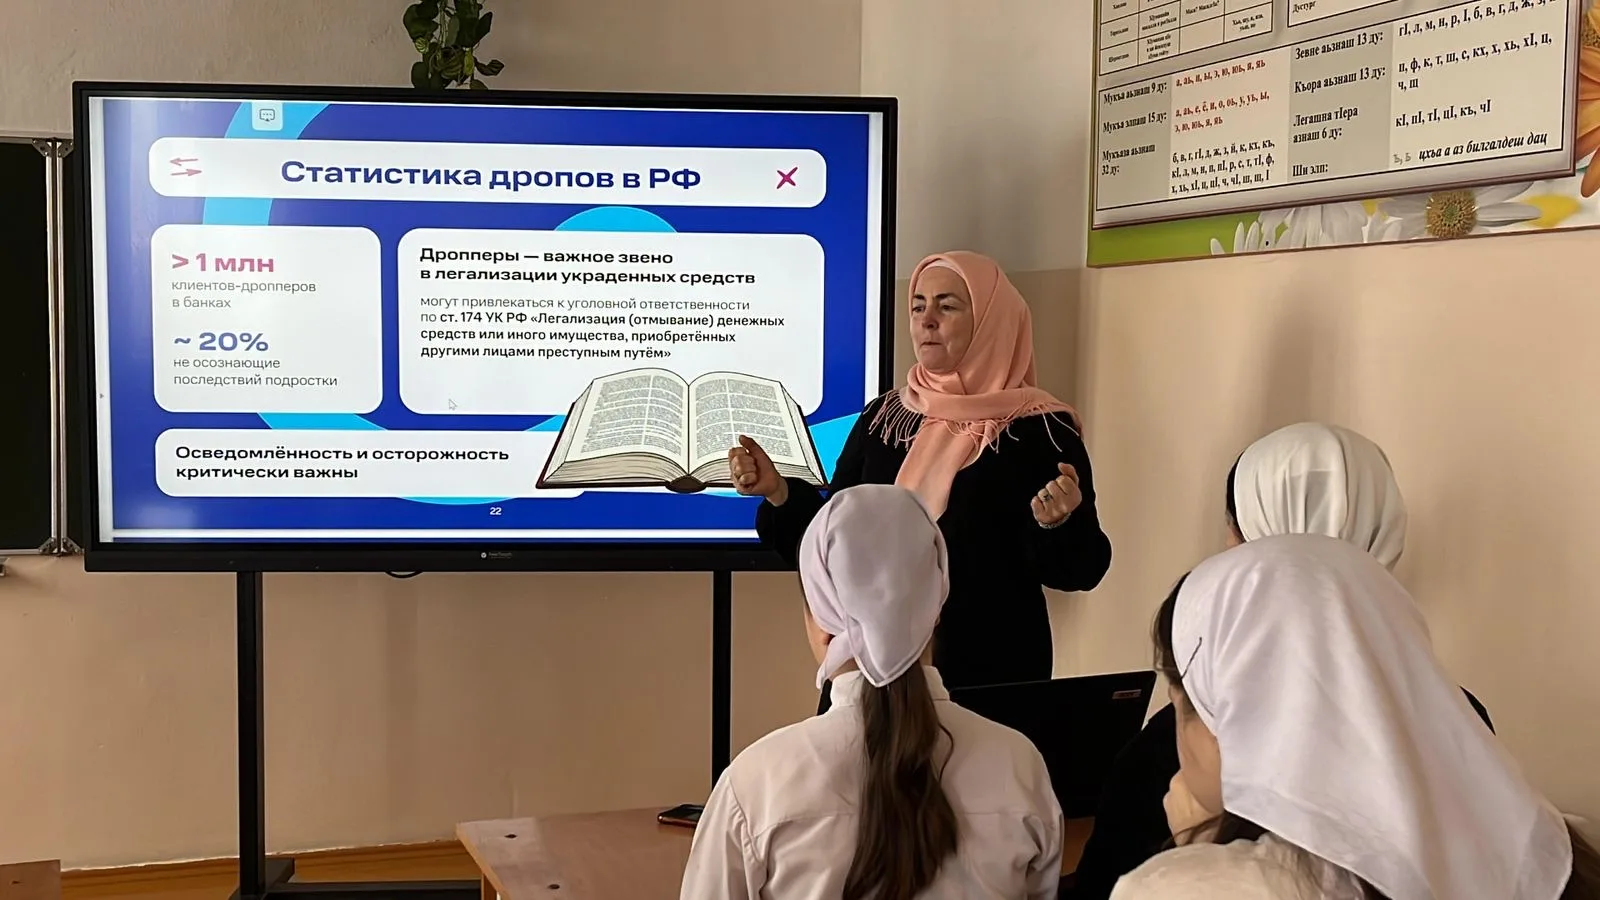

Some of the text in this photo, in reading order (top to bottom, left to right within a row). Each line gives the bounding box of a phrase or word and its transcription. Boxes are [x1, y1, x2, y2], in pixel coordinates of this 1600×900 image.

[1296, 32, 1383, 59] Зевне аьзнаш 13 ду:
[1295, 67, 1385, 93] Къора аьзнаш 13 ду:
[1293, 112, 1332, 126] Легашна
[1293, 127, 1342, 143] азнаш 6 ду:
[1444, 147, 1450, 156] а
[1453, 145, 1463, 155] аз
[1467, 136, 1523, 153] билгалдеш
[1527, 132, 1547, 145] дац
[281, 161, 701, 191] Статистика дропов в РФ
[1293, 165, 1308, 176] Ши
[196, 253, 206, 271] 1
[215, 258, 274, 272] млн
[420, 248, 519, 263] Дропперы
[544, 252, 614, 262] важное
[619, 253, 673, 263] звено
[421, 270, 755, 285] в легализации украденных средств
[172, 281, 316, 294] клиентов-дропперов
[172, 296, 231, 308] в банках
[421, 298, 749, 311] могут привлекаться к уголовной ответственности
[421, 312, 785, 327] по ст. 174 УК РФ «Легализация (отмывание) денежных
[199, 332, 268, 351] 20%
[421, 330, 736, 344] средств или иного имущества, приобретённых
[421, 347, 671, 360] другими лицами преступным путём»
[193, 359, 280, 369] осознающие
[174, 374, 338, 388] последствий подростки
[176, 446, 509, 463] Осведомлённость и осторожность
[176, 466, 358, 479] критически важны
[490, 507, 501, 515] 22
